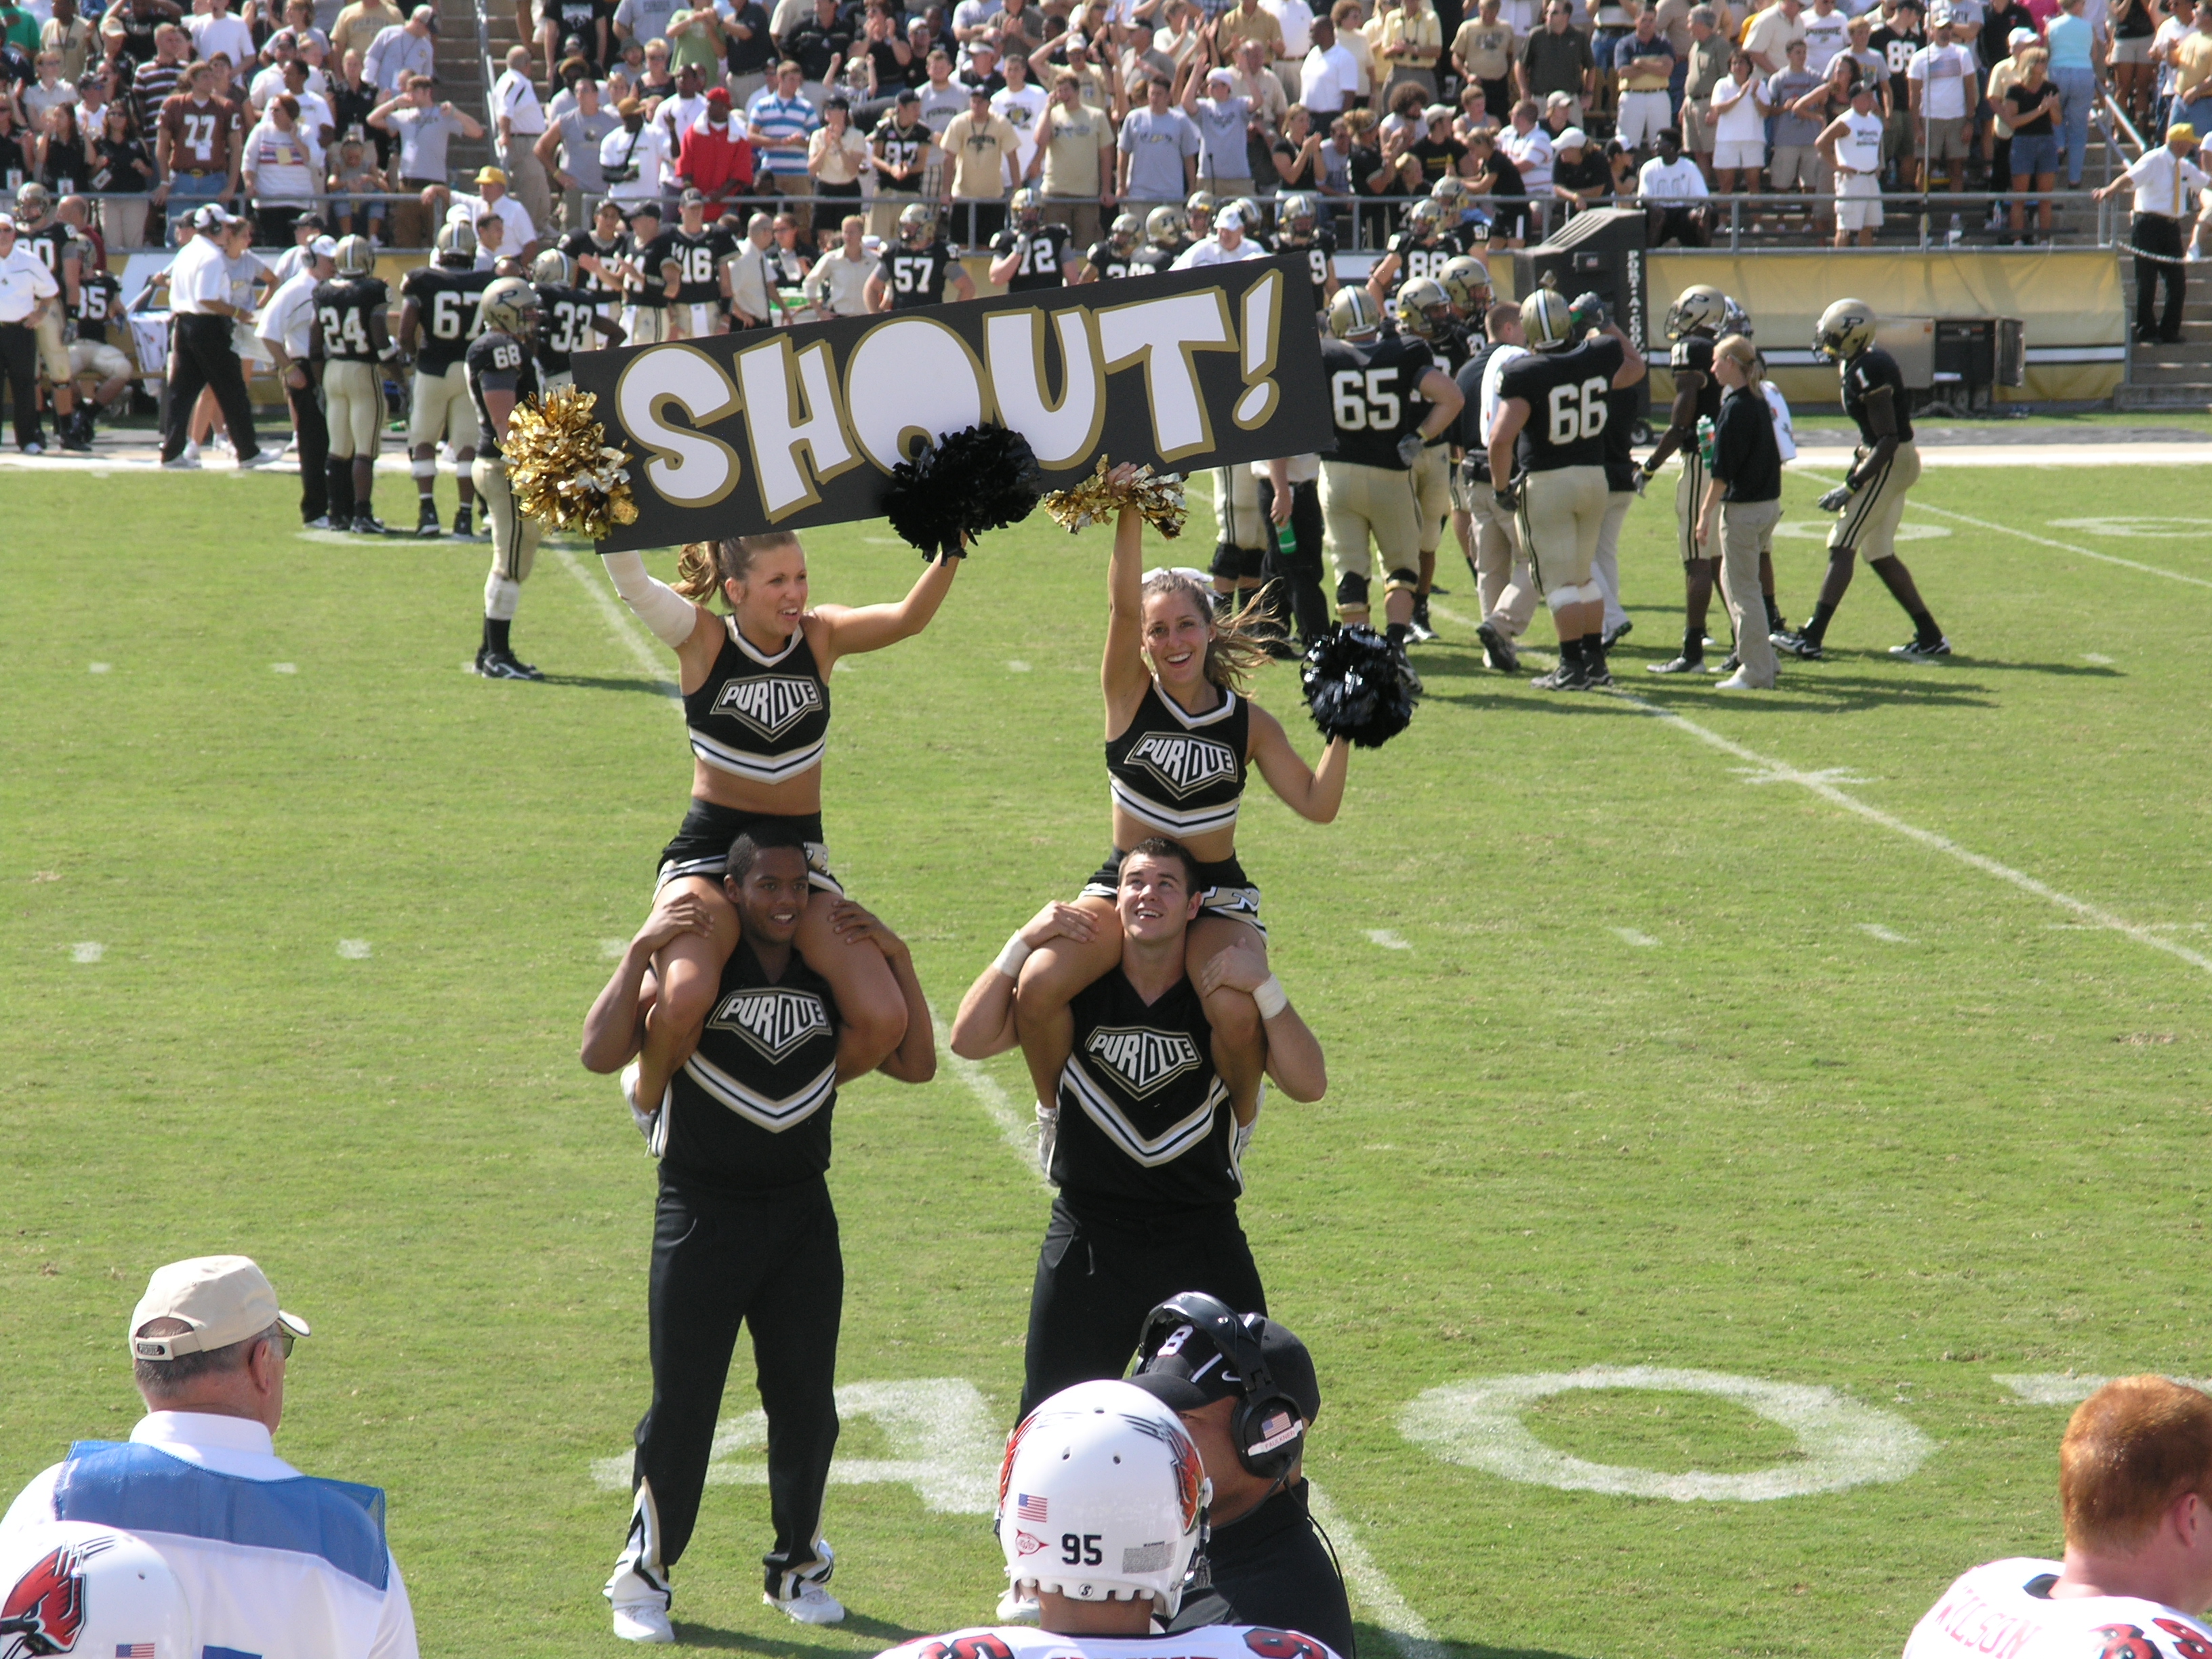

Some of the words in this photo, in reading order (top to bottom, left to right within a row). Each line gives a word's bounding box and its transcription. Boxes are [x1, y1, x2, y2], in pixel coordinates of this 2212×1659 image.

[680, 247, 712, 284] 16
[894, 257, 934, 293] 57
[319, 306, 370, 354] 24
[433, 290, 483, 340] 67
[550, 301, 592, 352] 33
[493, 344, 521, 370] 68
[615, 268, 1284, 523] SHOUT!
[1332, 367, 1400, 430] 65
[1549, 375, 1608, 446] 66
[720, 678, 821, 730] PURDUE
[1135, 738, 1235, 788] PURDUE
[720, 993, 827, 1050] PURDUE
[1088, 1031, 1197, 1087] PURDUE
[1265, 1430, 1296, 1450] FAULKNER
[1061, 1533, 1103, 1566] 95
